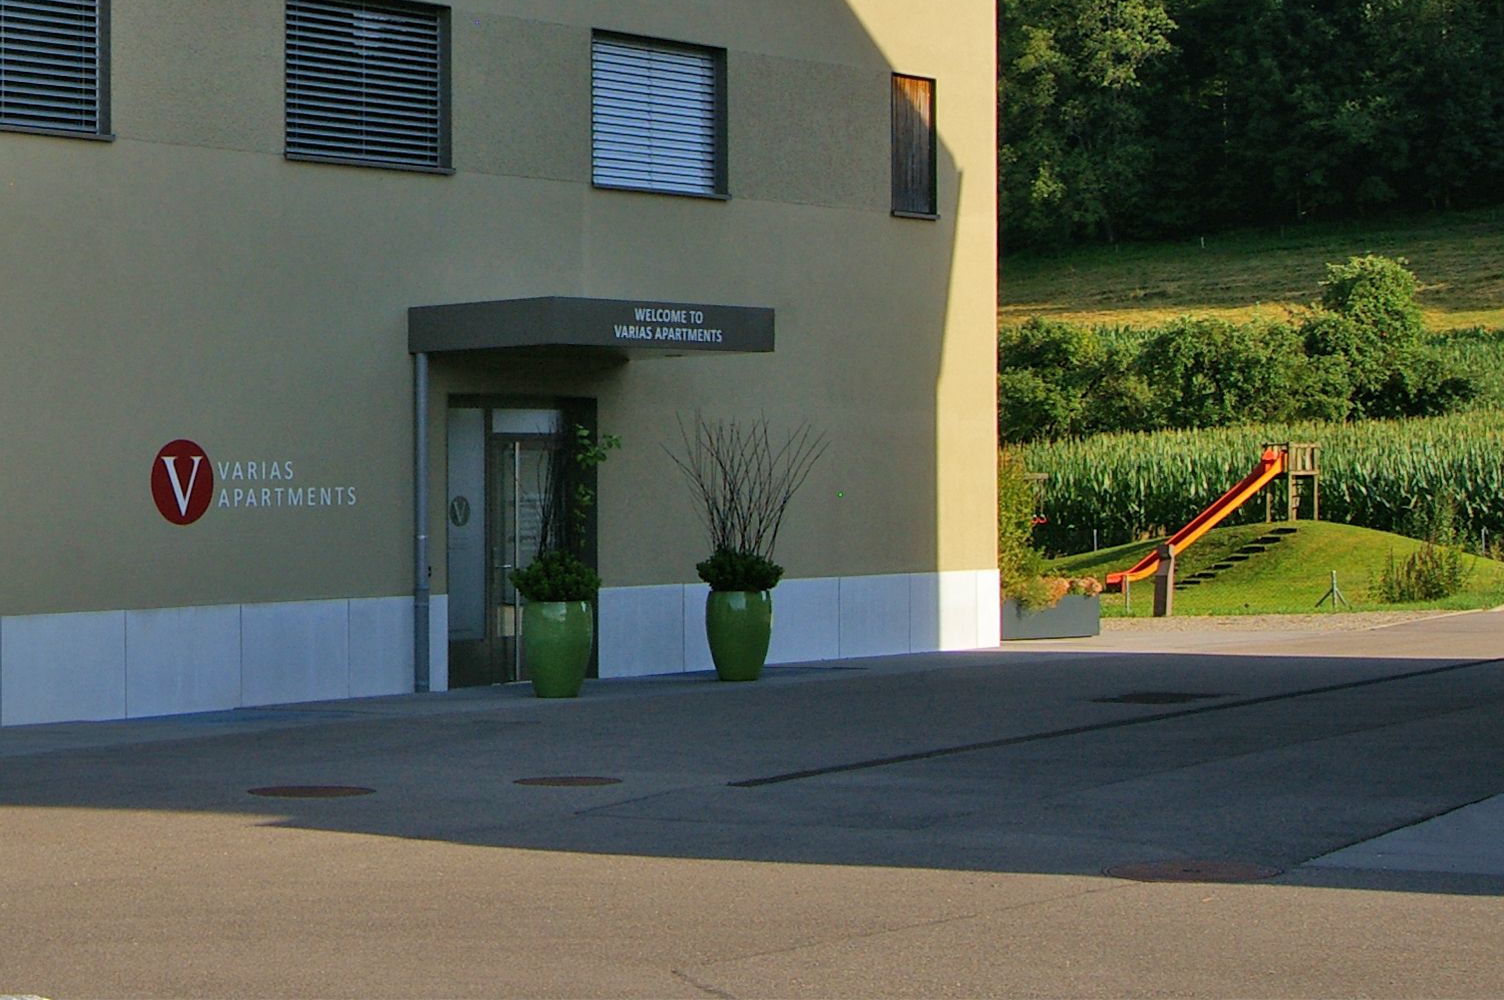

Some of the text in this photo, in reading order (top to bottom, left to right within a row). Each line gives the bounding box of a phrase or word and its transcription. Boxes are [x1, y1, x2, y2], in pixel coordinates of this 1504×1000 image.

[634, 307, 704, 325] WELCOME TO
[614, 324, 723, 343] VARIAS APARTMENTS
[217, 460, 294, 481] VARIAS
[160, 455, 204, 517] V
[218, 486, 357, 508] APARTMENTS
